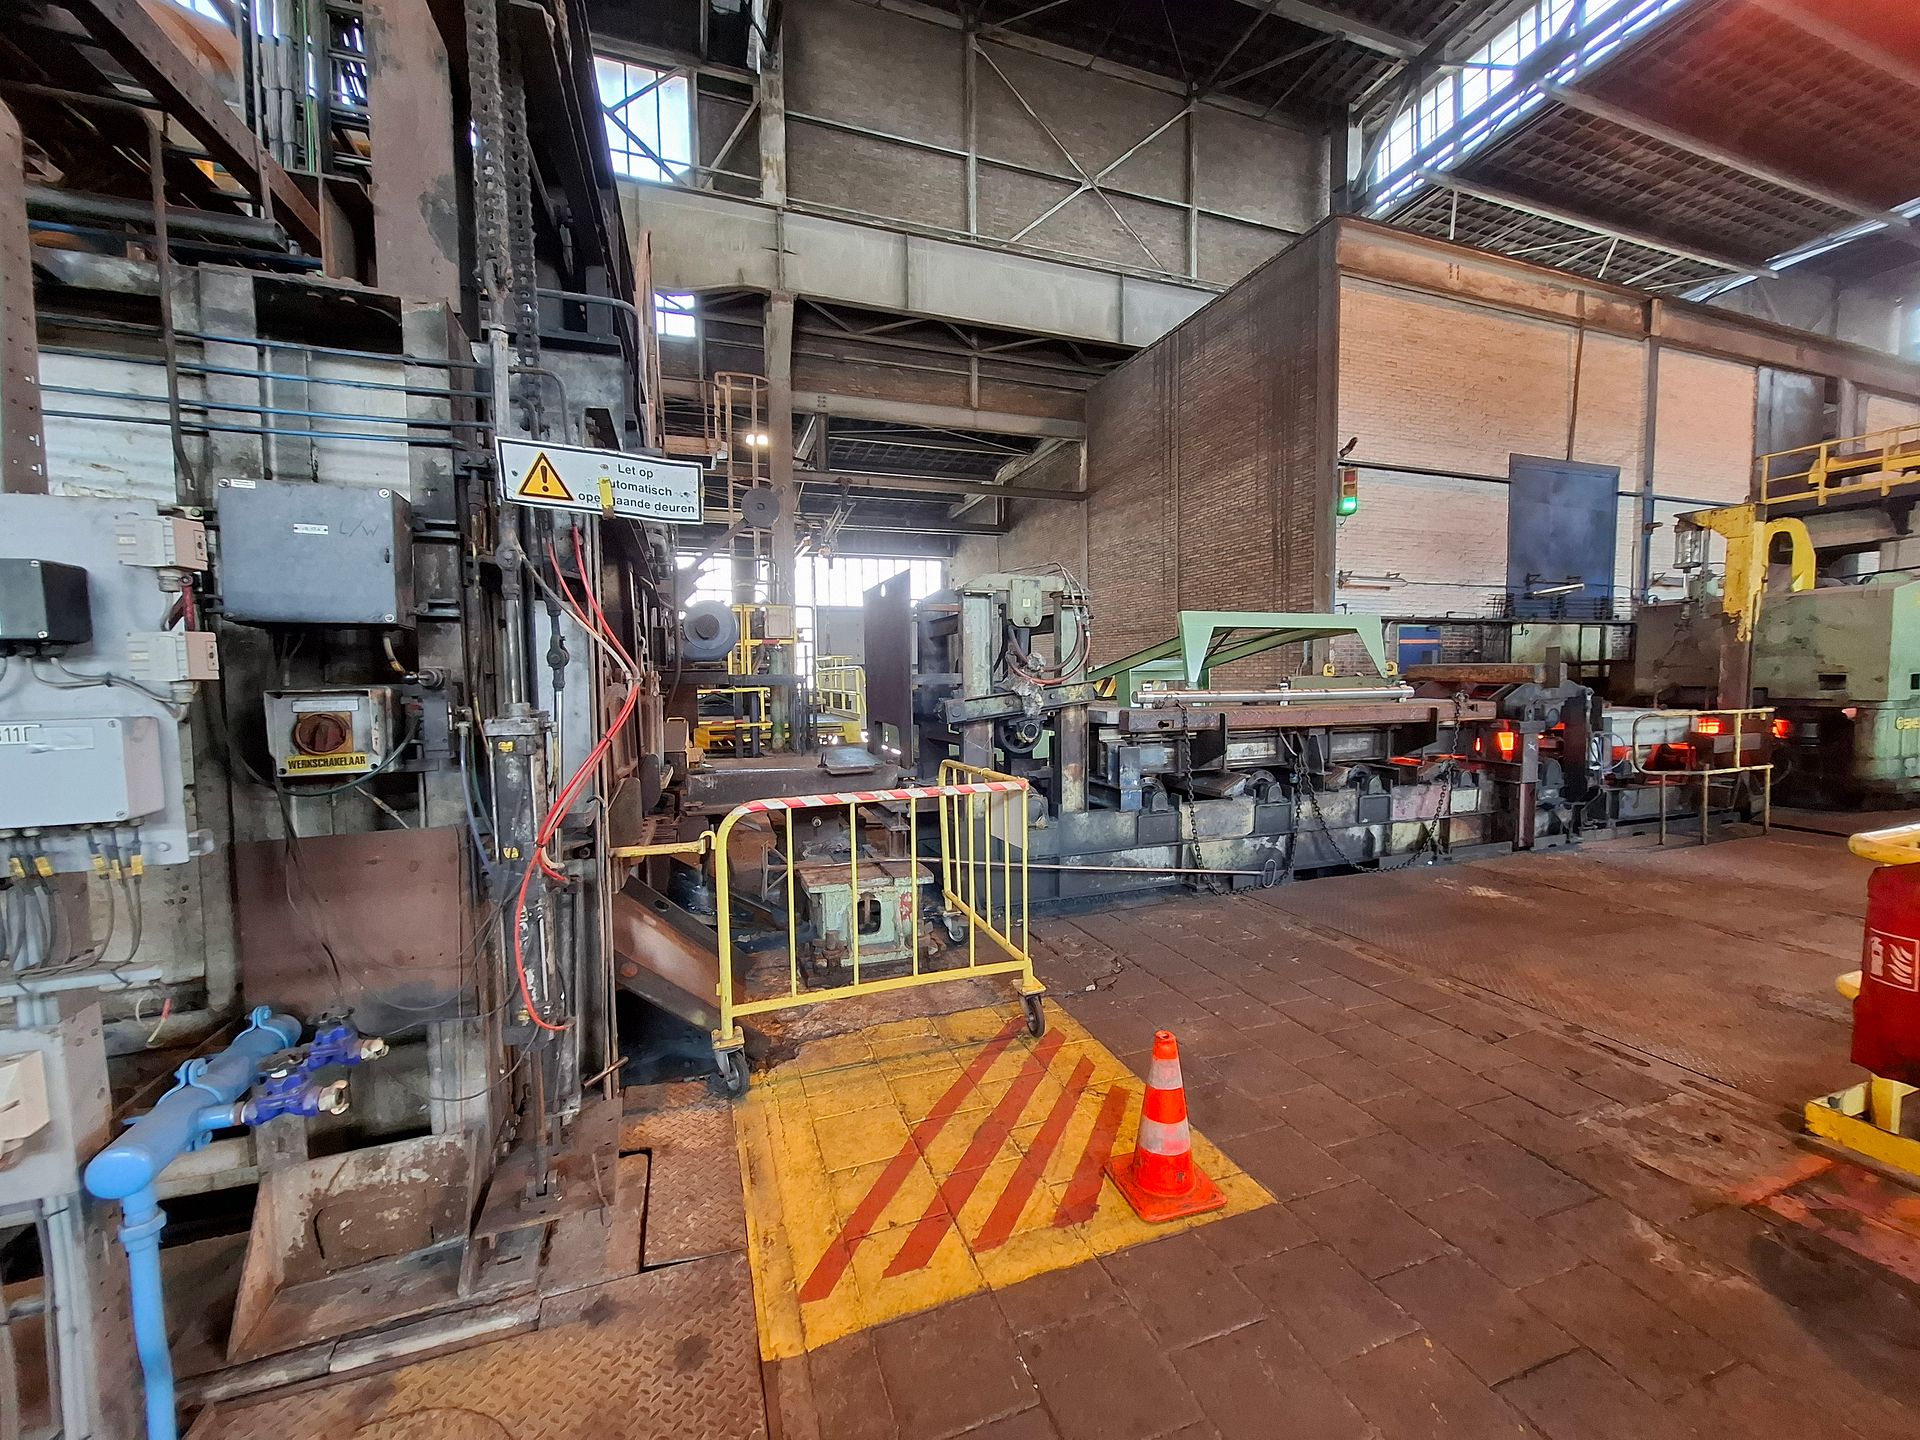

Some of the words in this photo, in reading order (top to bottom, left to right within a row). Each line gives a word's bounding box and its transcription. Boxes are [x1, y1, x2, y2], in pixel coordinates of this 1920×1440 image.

[617, 463, 636, 476] Let
[639, 468, 654, 480] op
[611, 479, 673, 497] utomatisch
[654, 502, 695, 513] deuren
[287, 755, 366, 770] WERKSCHAKELAAR
